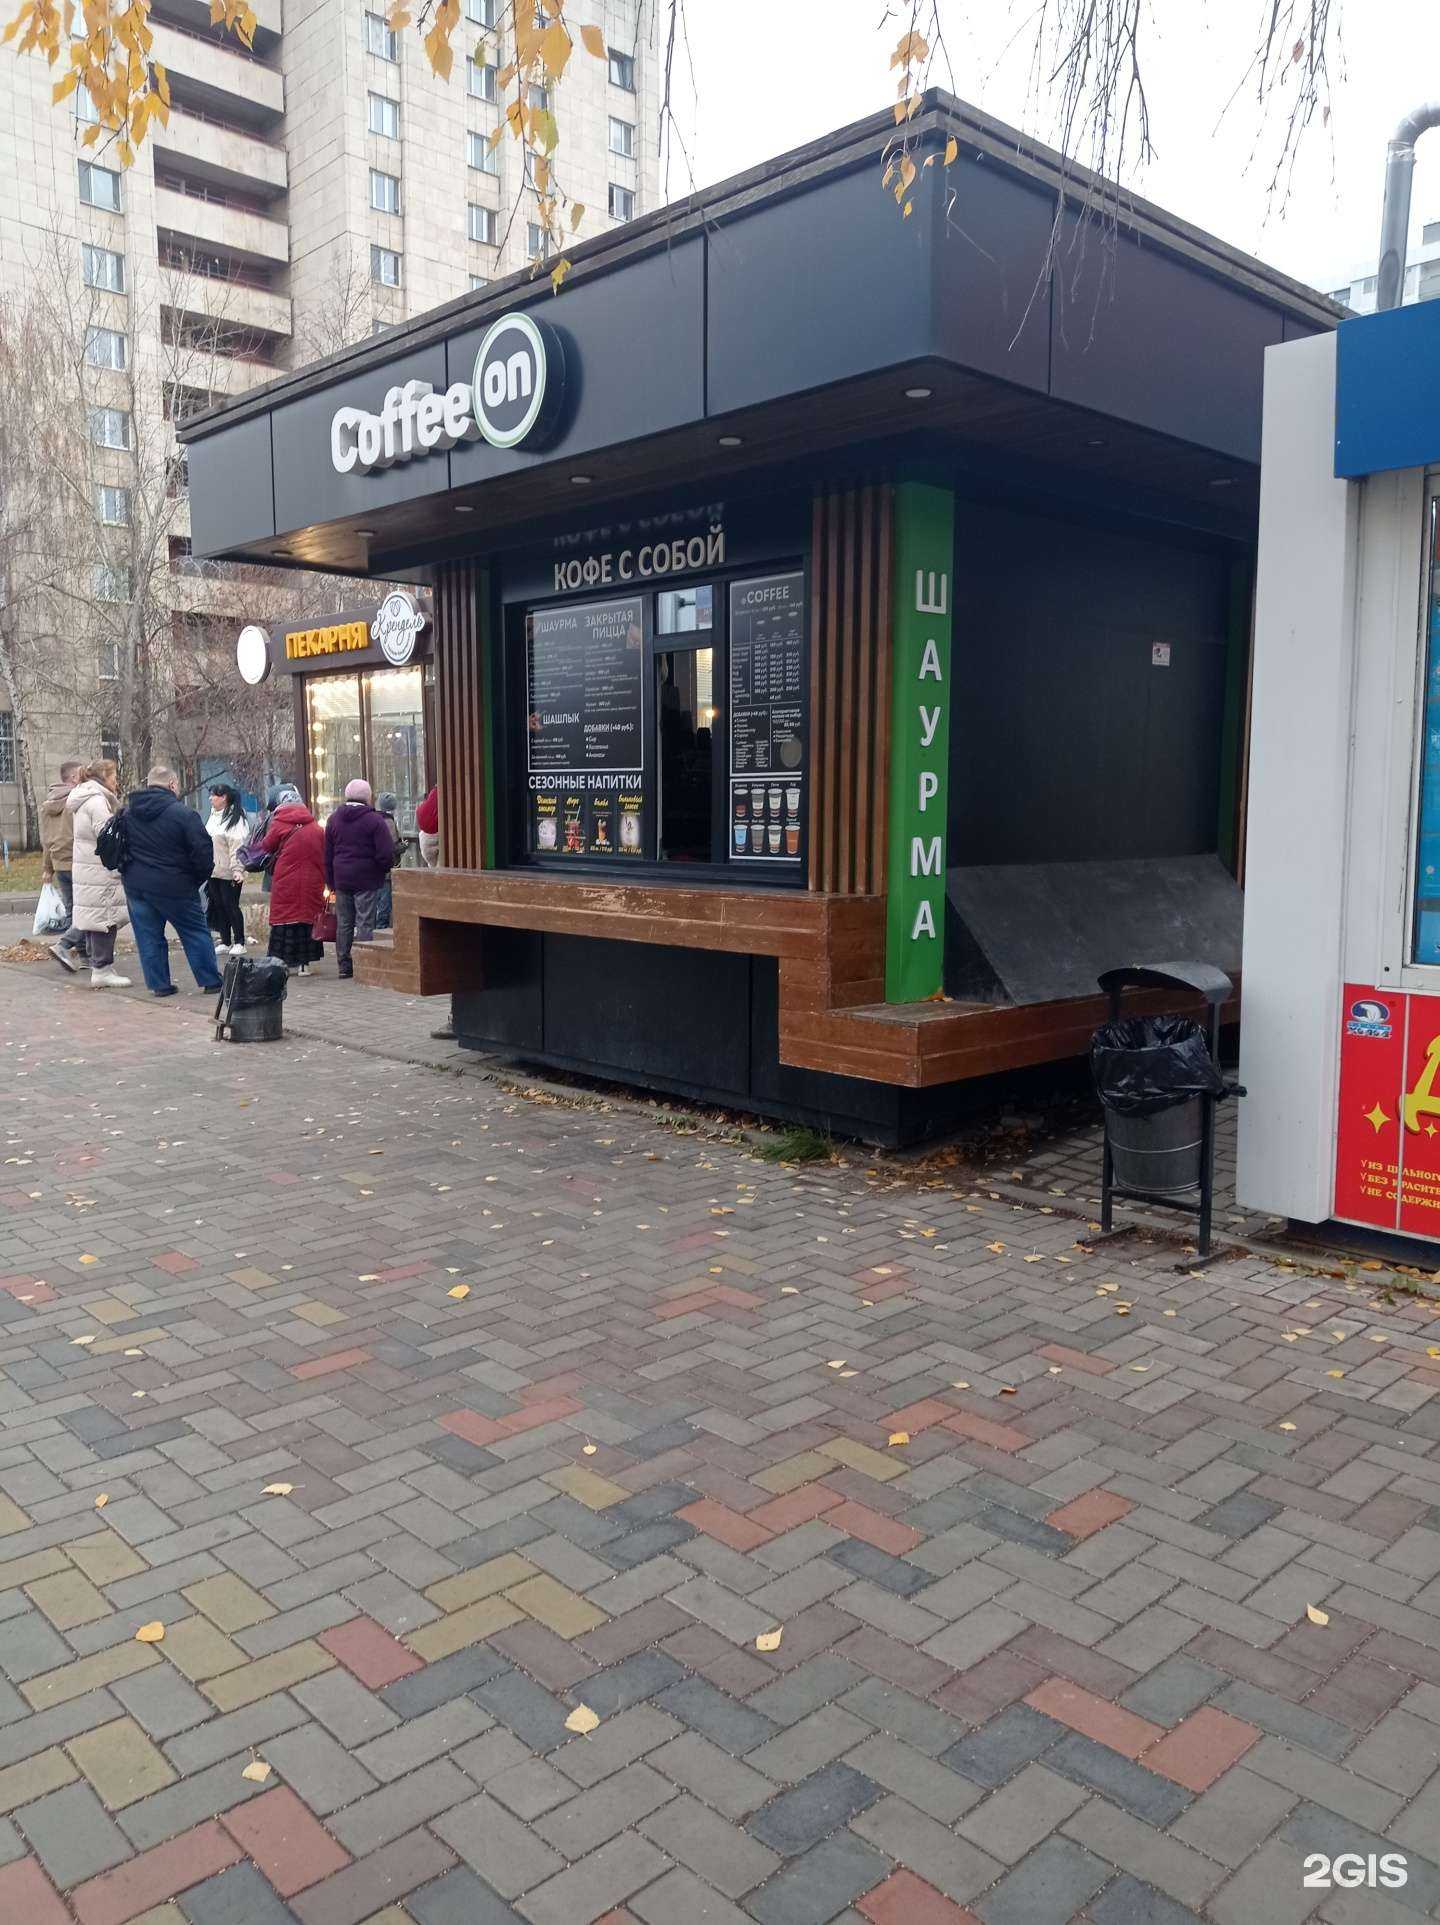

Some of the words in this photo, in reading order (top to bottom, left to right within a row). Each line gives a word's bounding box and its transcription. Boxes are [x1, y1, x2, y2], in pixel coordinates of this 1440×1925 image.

[331, 381, 477, 473] Coffee
[484, 350, 531, 408] on
[554, 554, 612, 590] КОФЕ
[618, 550, 632, 579] С
[638, 524, 725, 576] СОБОЙ
[747, 586, 789, 603] COFFEE
[541, 618, 577, 633] ШАУРМА
[584, 610, 633, 627] ЗАКРЫТАЯ
[285, 621, 368, 659] ПЕКАРНЯ
[592, 625, 625, 640] ПИЦЦА
[543, 712, 579, 724] ШАШЛЫК
[910, 569, 948, 941] ШАУРМА
[528, 776, 585, 789] СЕЗОННЫЕ
[587, 775, 642, 789] НАПИТКИ
[1367, 1174, 1388, 1185] БЕЗ
[1368, 1161, 1383, 1171] ИЗ
[1387, 1165, 1440, 1182] ЦЛЬНОГ
[1367, 1187, 1382, 1197] НЕ
